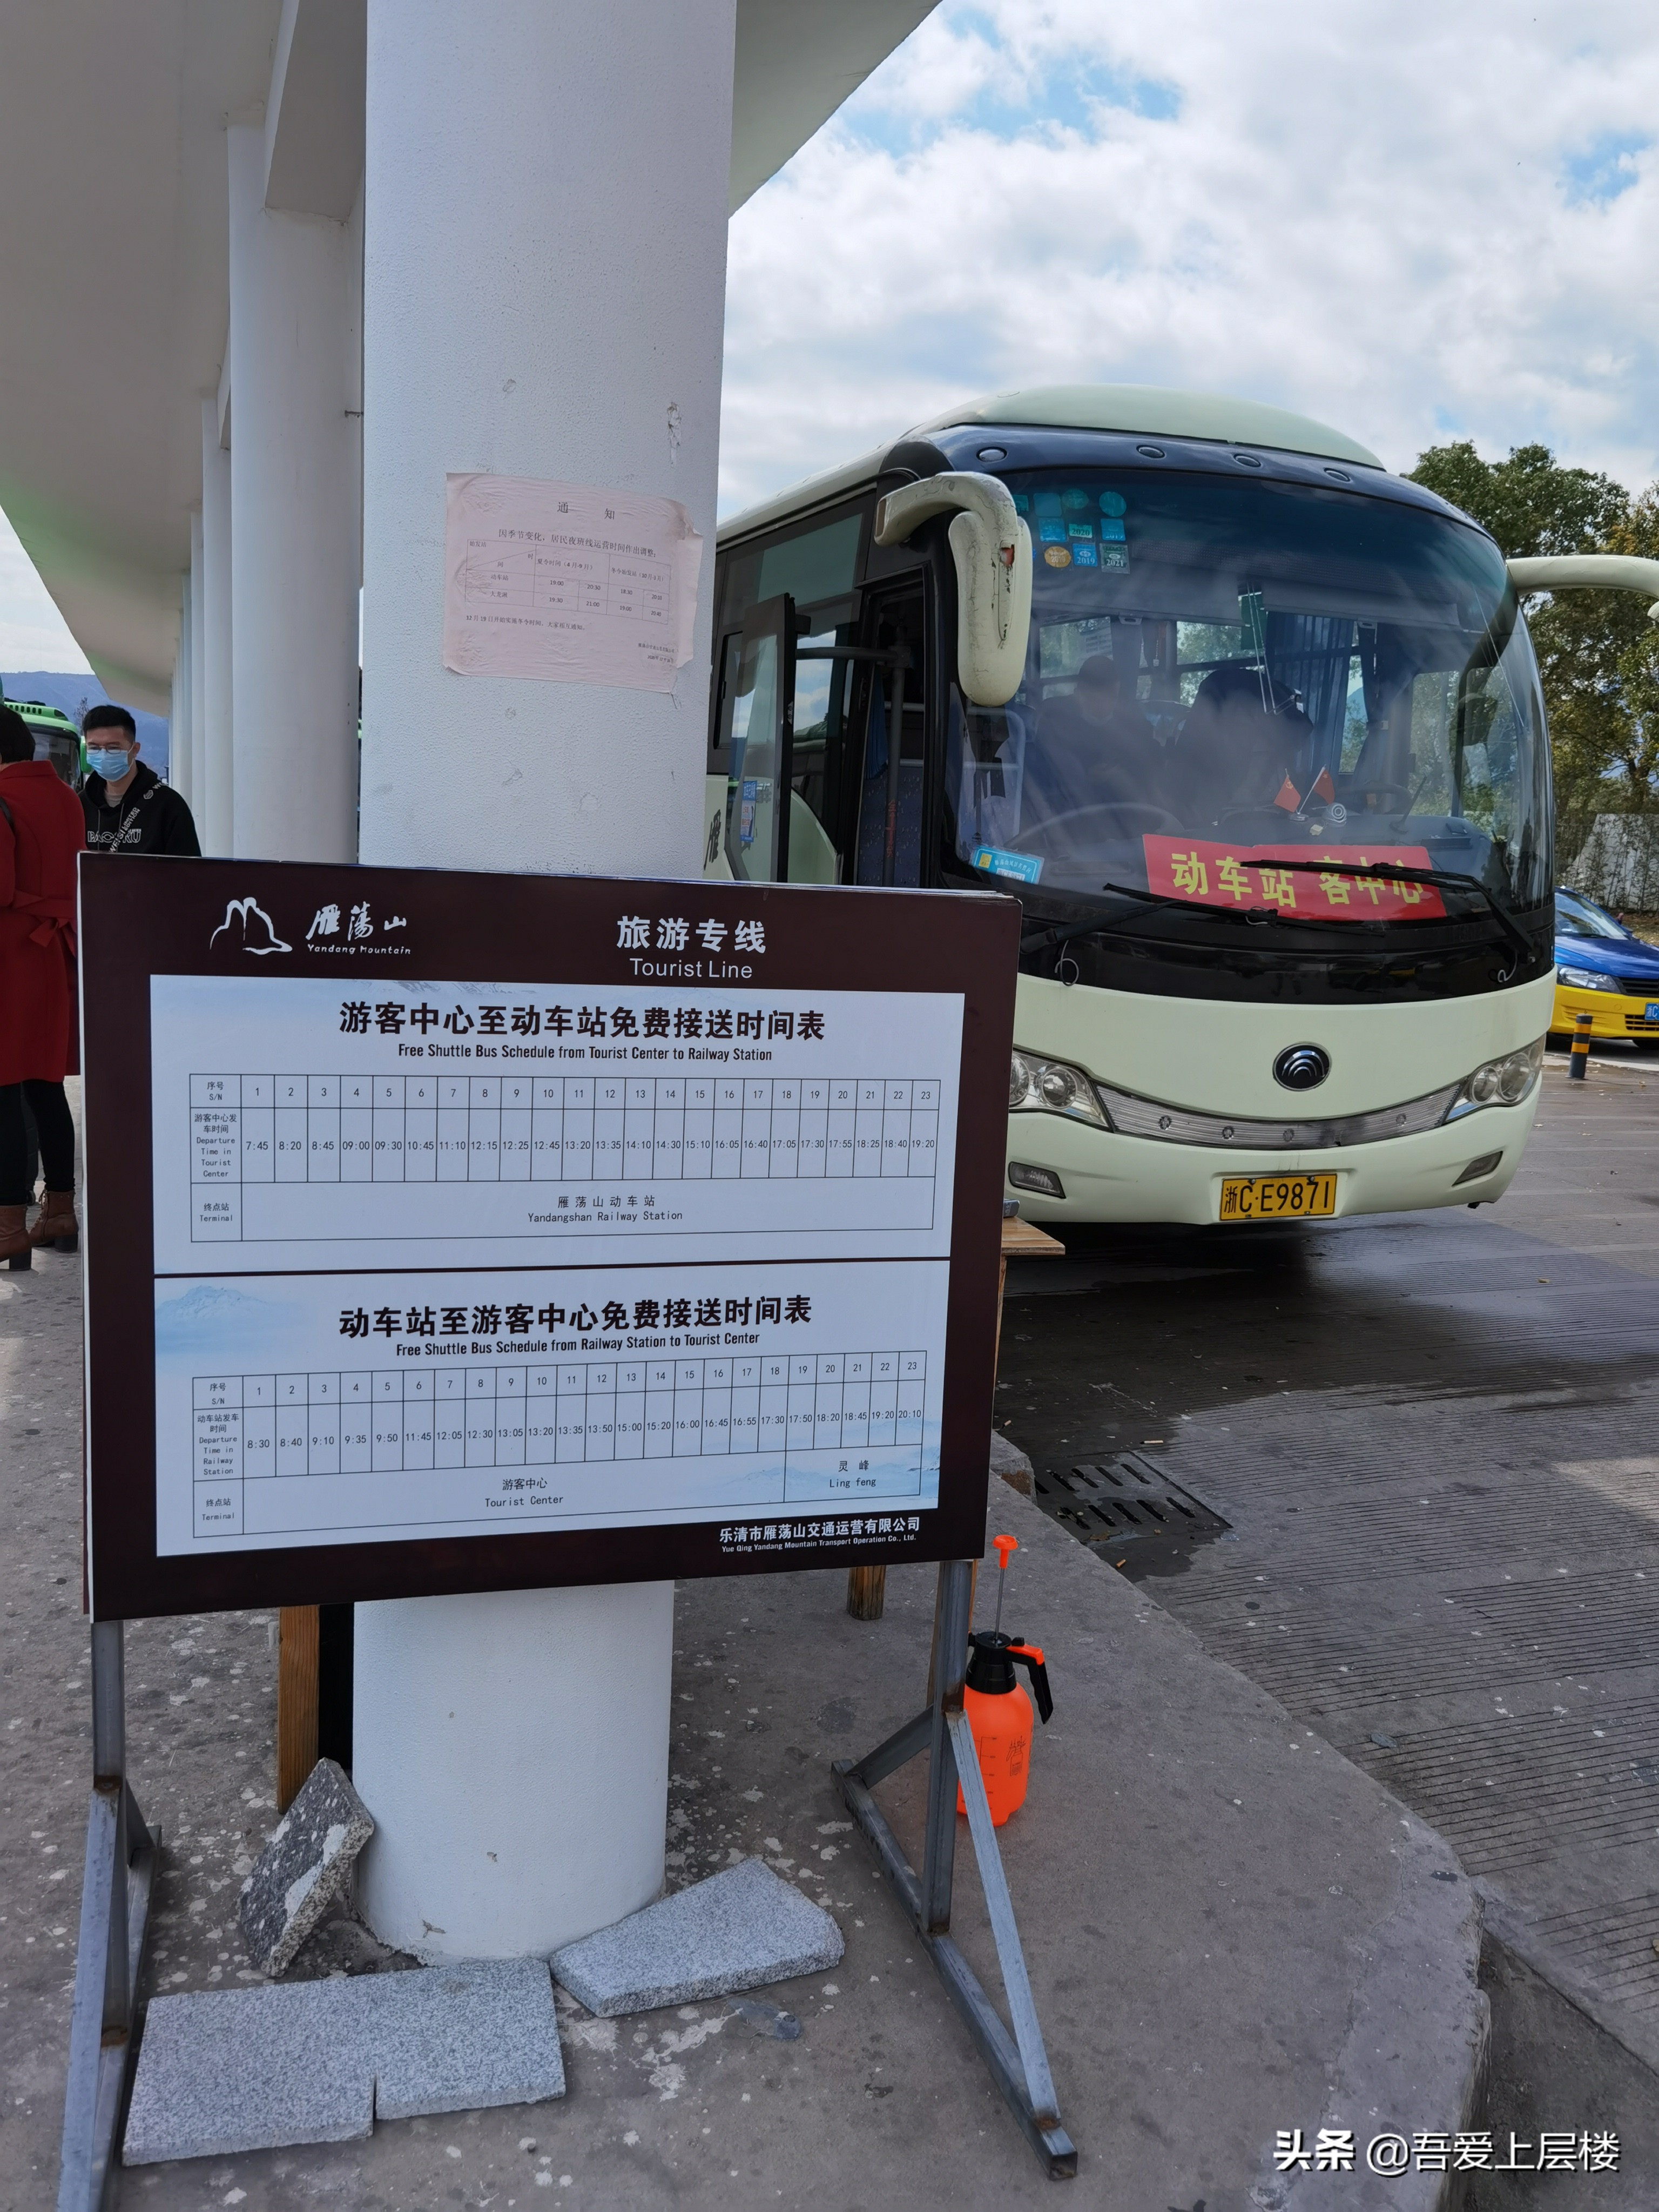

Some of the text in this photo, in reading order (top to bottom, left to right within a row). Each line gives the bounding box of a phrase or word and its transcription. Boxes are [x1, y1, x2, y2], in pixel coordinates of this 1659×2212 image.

[557, 502, 615, 520] 通知
[1071, 528, 1090, 536] 2020
[617, 916, 766, 953] 旅游专线
[308, 944, 410, 954] Yandang Mountain
[630, 958, 752, 978] Tourist Line
[340, 1001, 825, 1040] 游客中心至动车站免费接送时间表
[399, 1044, 771, 1062] Free Shuttle Bus Schedule from Tourist Center to Railway Station
[207, 1082, 224, 1090] 序号
[194, 1114, 237, 1122] 游客中心发
[204, 1125, 228, 1133] 车时间
[246, 1142, 268, 1150] 7:45
[279, 1141, 301, 1150] 8:20
[312, 1141, 334, 1150] 8:45
[343, 1141, 369, 1150] 09:00
[375, 1141, 402, 1150] 09:30
[408, 1141, 434, 1150] 10:45
[440, 1141, 466, 1150] 11:10
[471, 1141, 497, 1150] 12:15
[503, 1141, 529, 1149] 12:25
[535, 1141, 559, 1149] 12:45
[565, 1141, 590, 1149] 13:20
[626, 1141, 651, 1149] 14:10
[657, 1141, 680, 1149] 14:30
[686, 1141, 710, 1149] 15:10
[716, 1140, 739, 1148] 16:05
[744, 1140, 767, 1148] 16:40
[204, 1195, 655, 1211] 终点站 雁荡山动车站
[528, 1212, 591, 1223] Yandangshan
[598, 1212, 637, 1222] Railway
[644, 1211, 682, 1220] Station
[339, 1295, 812, 1338] 动车站至游客中心免费接送时间表
[397, 1333, 760, 1355] Free Shuttle Bus Schedule from Railway Station to Tourist Center
[210, 1383, 226, 1391] 序号
[198, 1413, 239, 1422] 动车站发车
[210, 1425, 226, 1433] 时间
[248, 1410, 921, 1448] 8:30 8:40 9:10 9:35 9:50 11:45 12:05 12:30 13:05 13:20 13:35 13:50 15:00 15:20 16:00 16:45 16:55 17:30 17:50 18:20 18:45 19:20 20:10
[206, 1460, 869, 1507] 终点站 游客中心 灵峰
[485, 1497, 524, 1507] Tourist
[531, 1496, 563, 1505] Center
[830, 1479, 850, 1488] Ling
[856, 1478, 876, 1487] feng
[719, 1516, 920, 1543] 乐清市雁荡山交通运营有限公司
